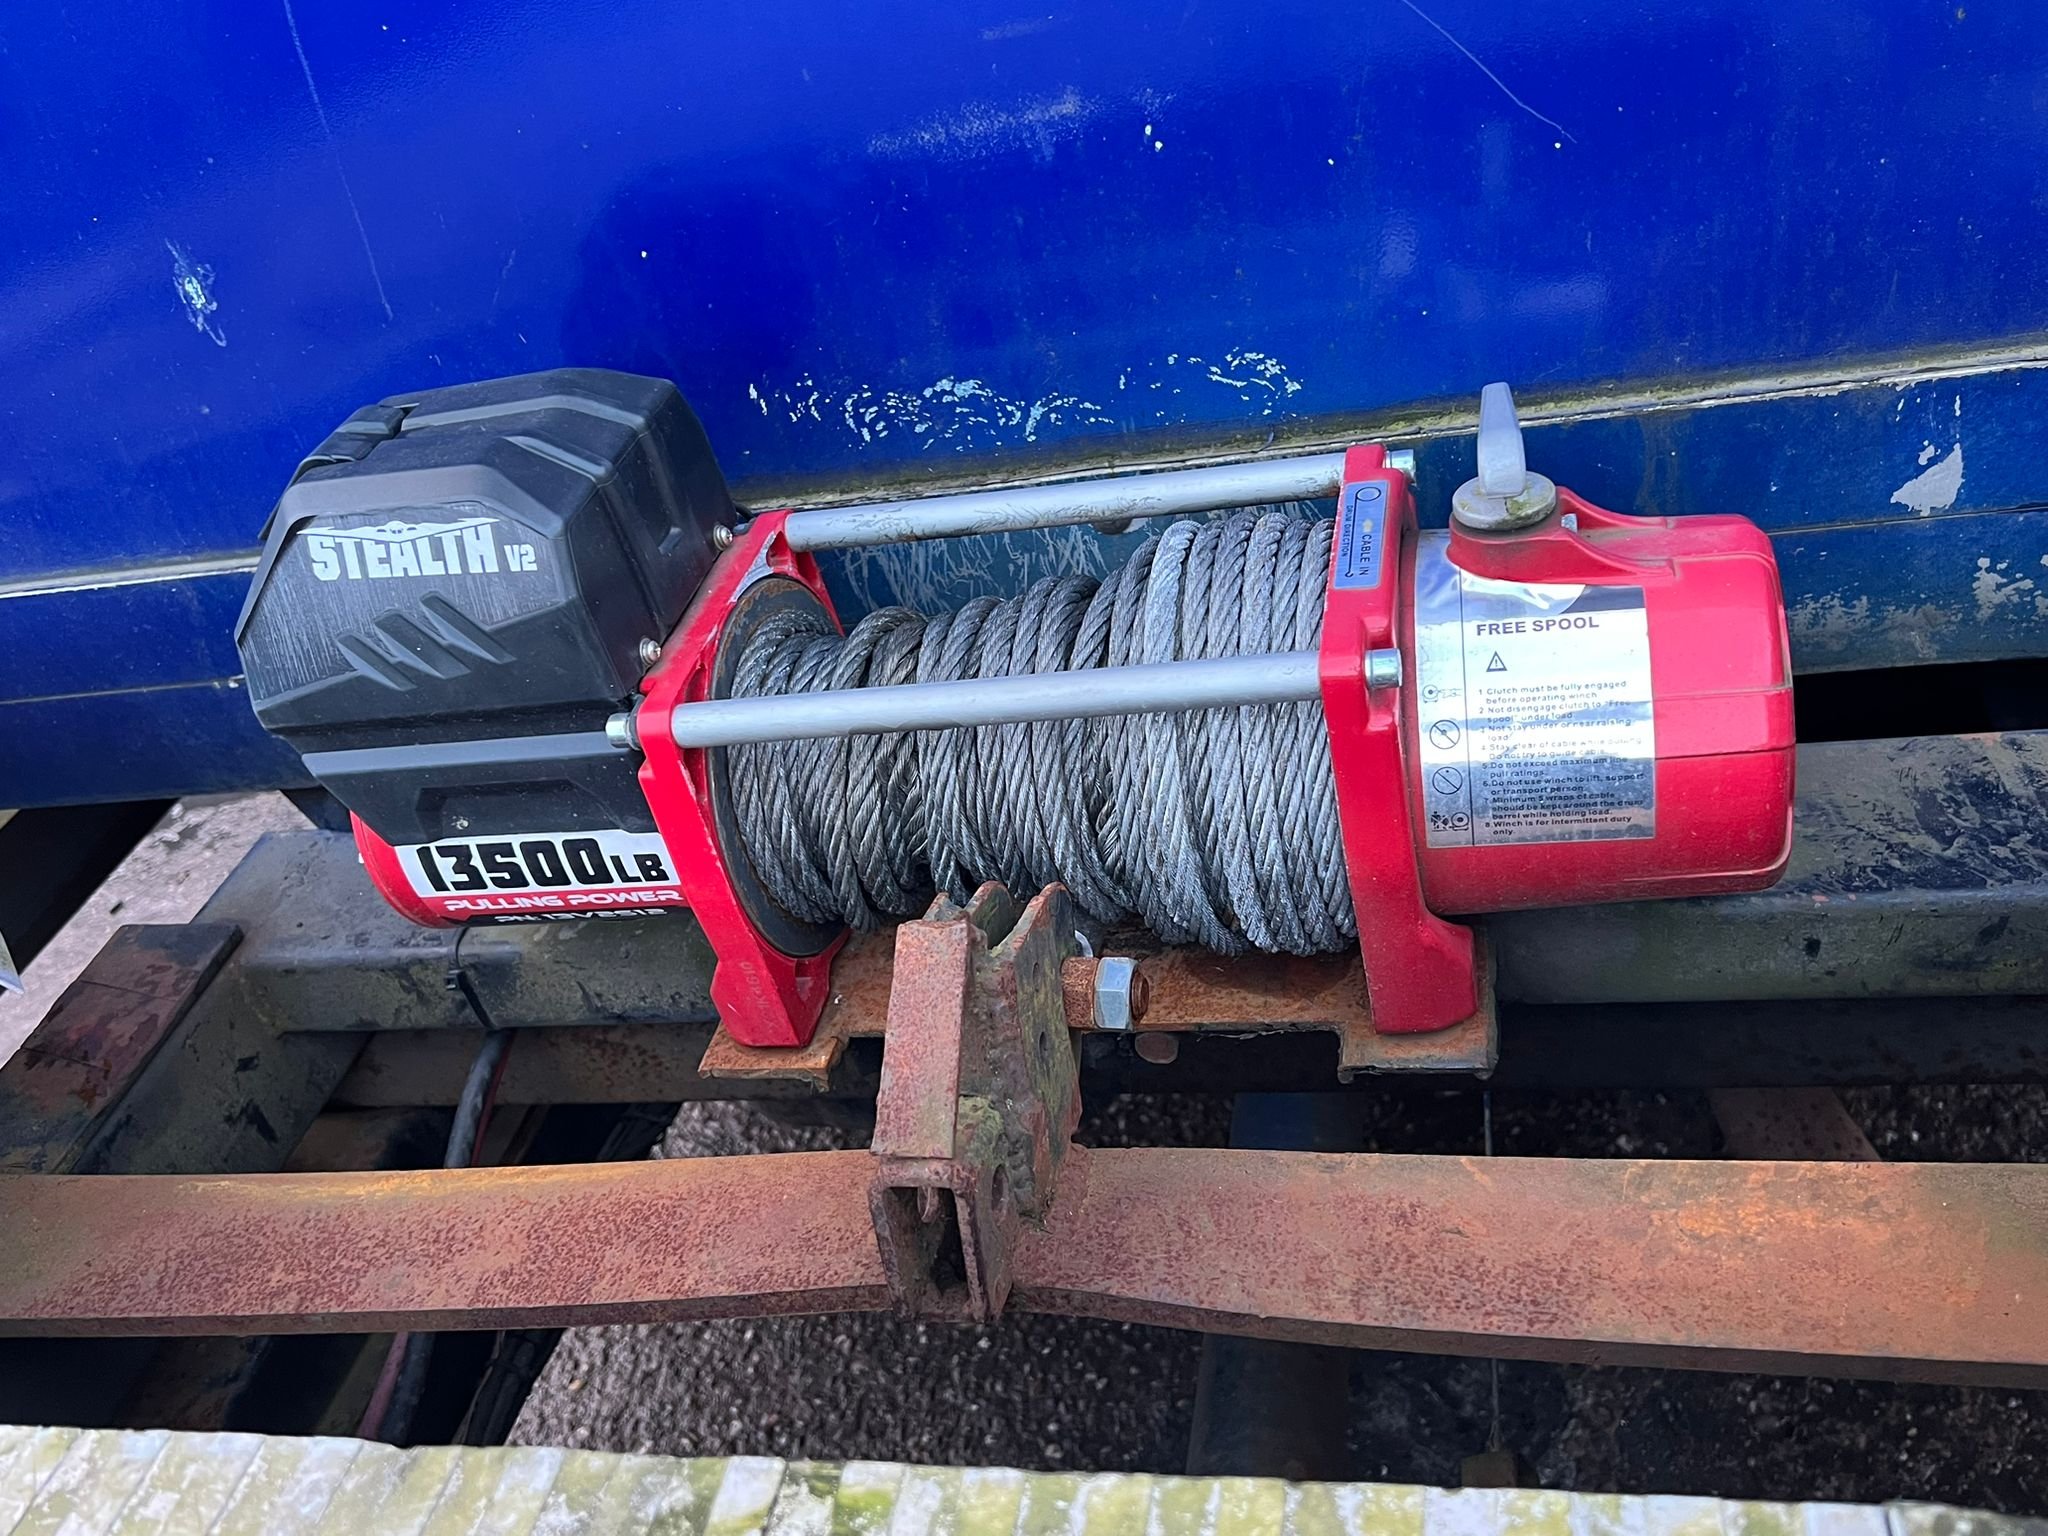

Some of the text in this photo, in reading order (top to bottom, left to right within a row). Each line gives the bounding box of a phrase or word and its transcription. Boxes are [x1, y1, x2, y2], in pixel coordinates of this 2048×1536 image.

[1341, 524, 1352, 557] DIRECTION
[307, 524, 538, 581] STEALTH V2
[1359, 534, 1372, 576] CABLE IN
[1476, 617, 1600, 636] FREE SPOOL
[1486, 687, 1518, 695] Clutch
[1520, 685, 1544, 693] must
[1546, 684, 1558, 692] be
[1560, 682, 1581, 691] fully
[1584, 680, 1627, 690] engaged
[1485, 691, 1598, 704] before operating winch
[1506, 704, 1557, 712] disengage
[1559, 701, 1590, 709] clutch
[1521, 713, 1550, 721] under
[1506, 724, 1528, 732] stay
[1530, 722, 1558, 730] under
[1596, 718, 1632, 727] raising
[1489, 743, 1510, 752] Stay
[1512, 742, 1536, 750] clear
[1522, 752, 1535, 760] try
[1505, 761, 1522, 769] not
[1523, 759, 1558, 768] exceed
[1560, 757, 1607, 766] maximum
[1490, 770, 1508, 779] pull
[1544, 776, 1573, 784] winch
[1605, 773, 1645, 782] support
[1502, 786, 1548, 795] transport
[1588, 791, 1615, 799] cable
[1491, 804, 1525, 812] should
[1526, 803, 1538, 811] be
[1540, 802, 1562, 810] kept
[1563, 800, 1598, 809] around
[1492, 812, 1520, 820] barrel
[1522, 811, 1547, 819] while
[1549, 810, 1587, 818] holding
[1535, 818, 1550, 826] for
[1551, 816, 1608, 825] intermittent
[1609, 815, 1633, 824] duty
[444, 889, 684, 911] PULLING POWER
